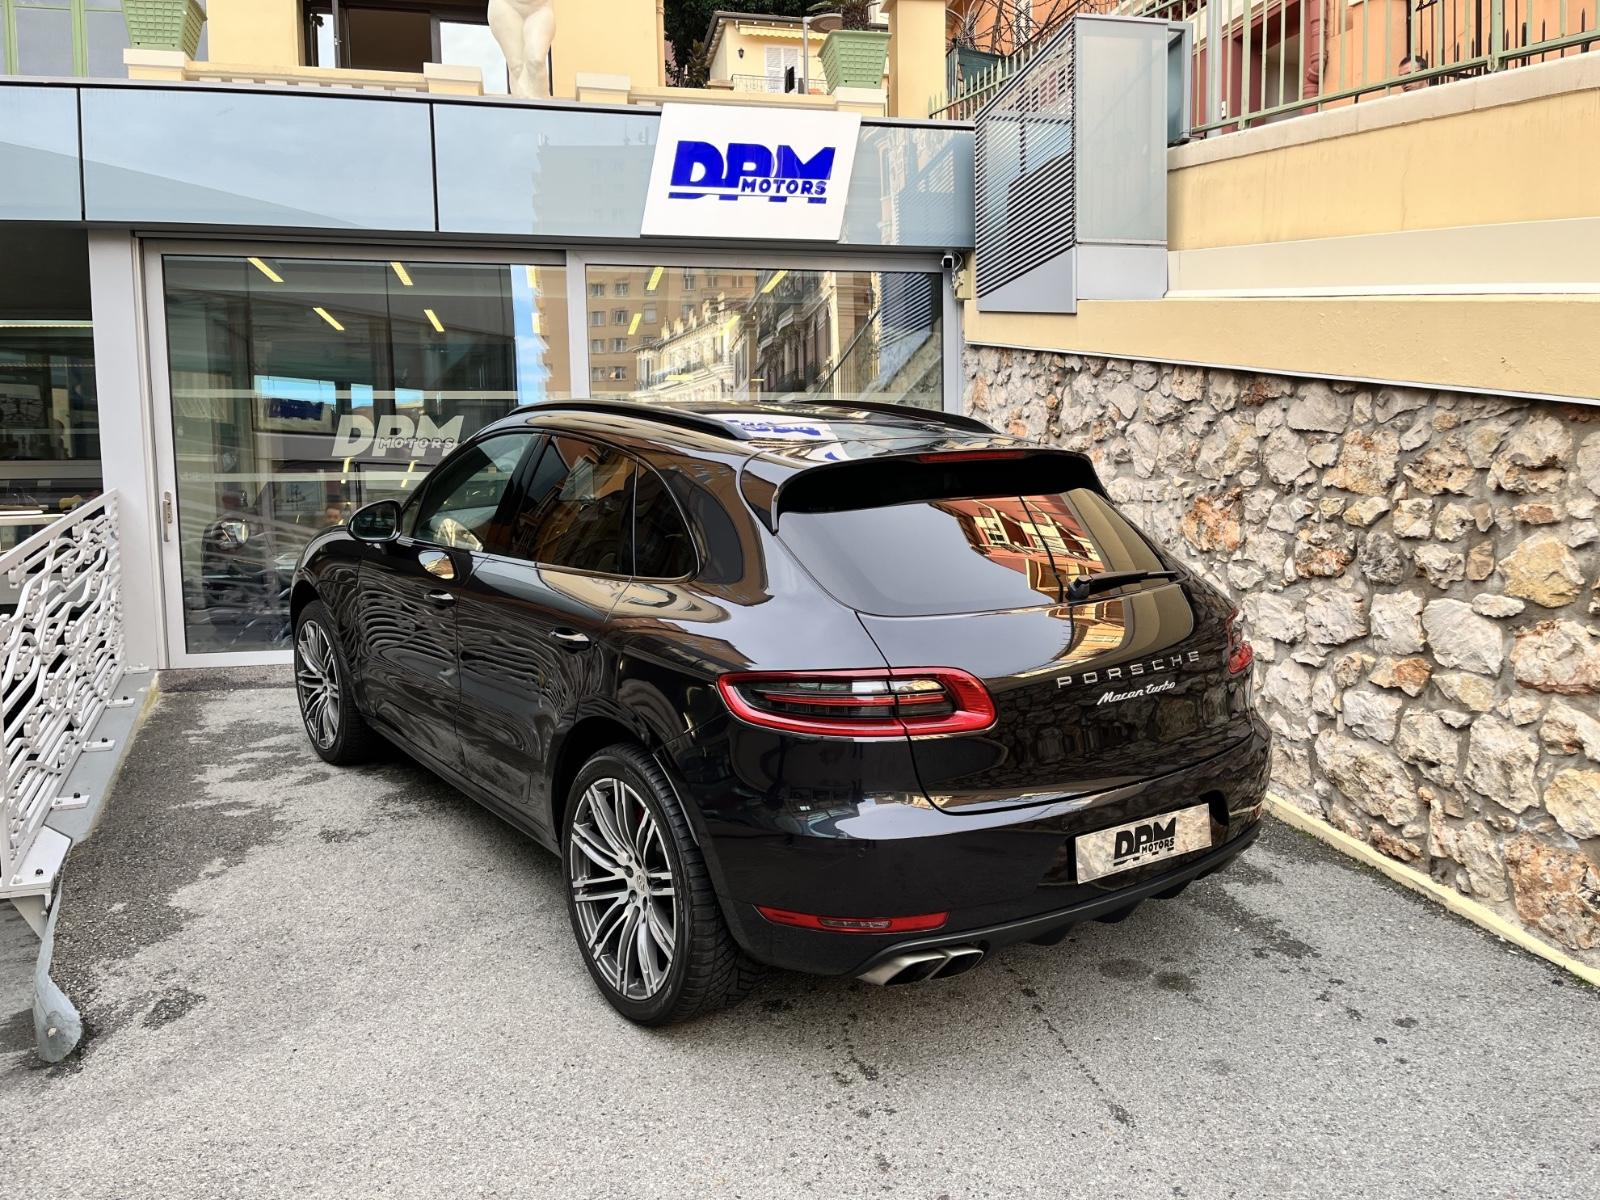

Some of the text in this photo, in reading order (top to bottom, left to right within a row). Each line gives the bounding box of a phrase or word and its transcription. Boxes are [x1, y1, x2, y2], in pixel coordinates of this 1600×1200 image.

[668, 140, 836, 204] DPM
[741, 177, 827, 195] MOTORS
[331, 414, 464, 457] DPM
[379, 437, 456, 449] MOTORS
[1056, 651, 1199, 688] PORSCHE
[1096, 680, 1176, 706] Macan turbo
[1113, 817, 1177, 866] DPM
[1141, 838, 1175, 854] MOTORS
